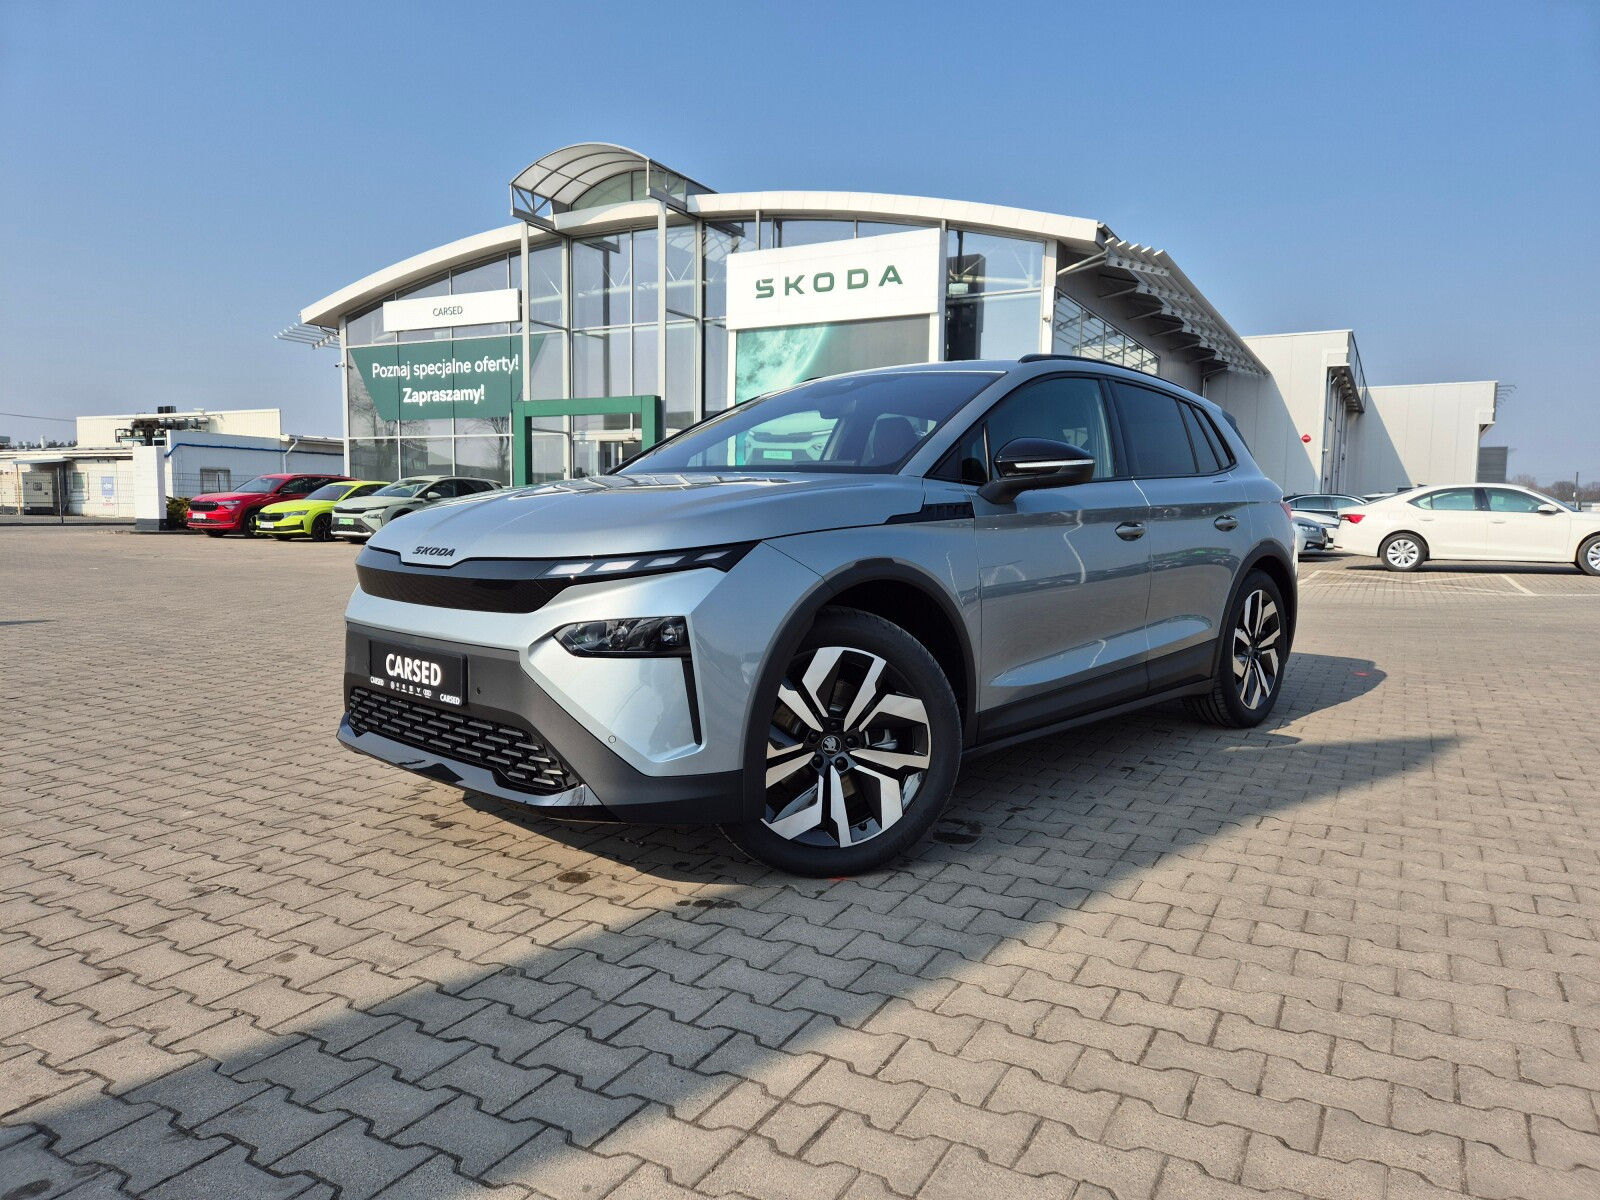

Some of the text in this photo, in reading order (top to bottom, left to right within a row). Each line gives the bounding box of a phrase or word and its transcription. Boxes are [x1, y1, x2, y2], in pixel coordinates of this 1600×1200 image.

[433, 305, 463, 317] CARSED
[372, 354, 519, 380] Poznaj specjalne oferty!
[402, 384, 485, 406] Zapraszamy!
[412, 546, 456, 557] SKODA
[385, 653, 441, 686] CARSED
[440, 694, 460, 705] CARSED
